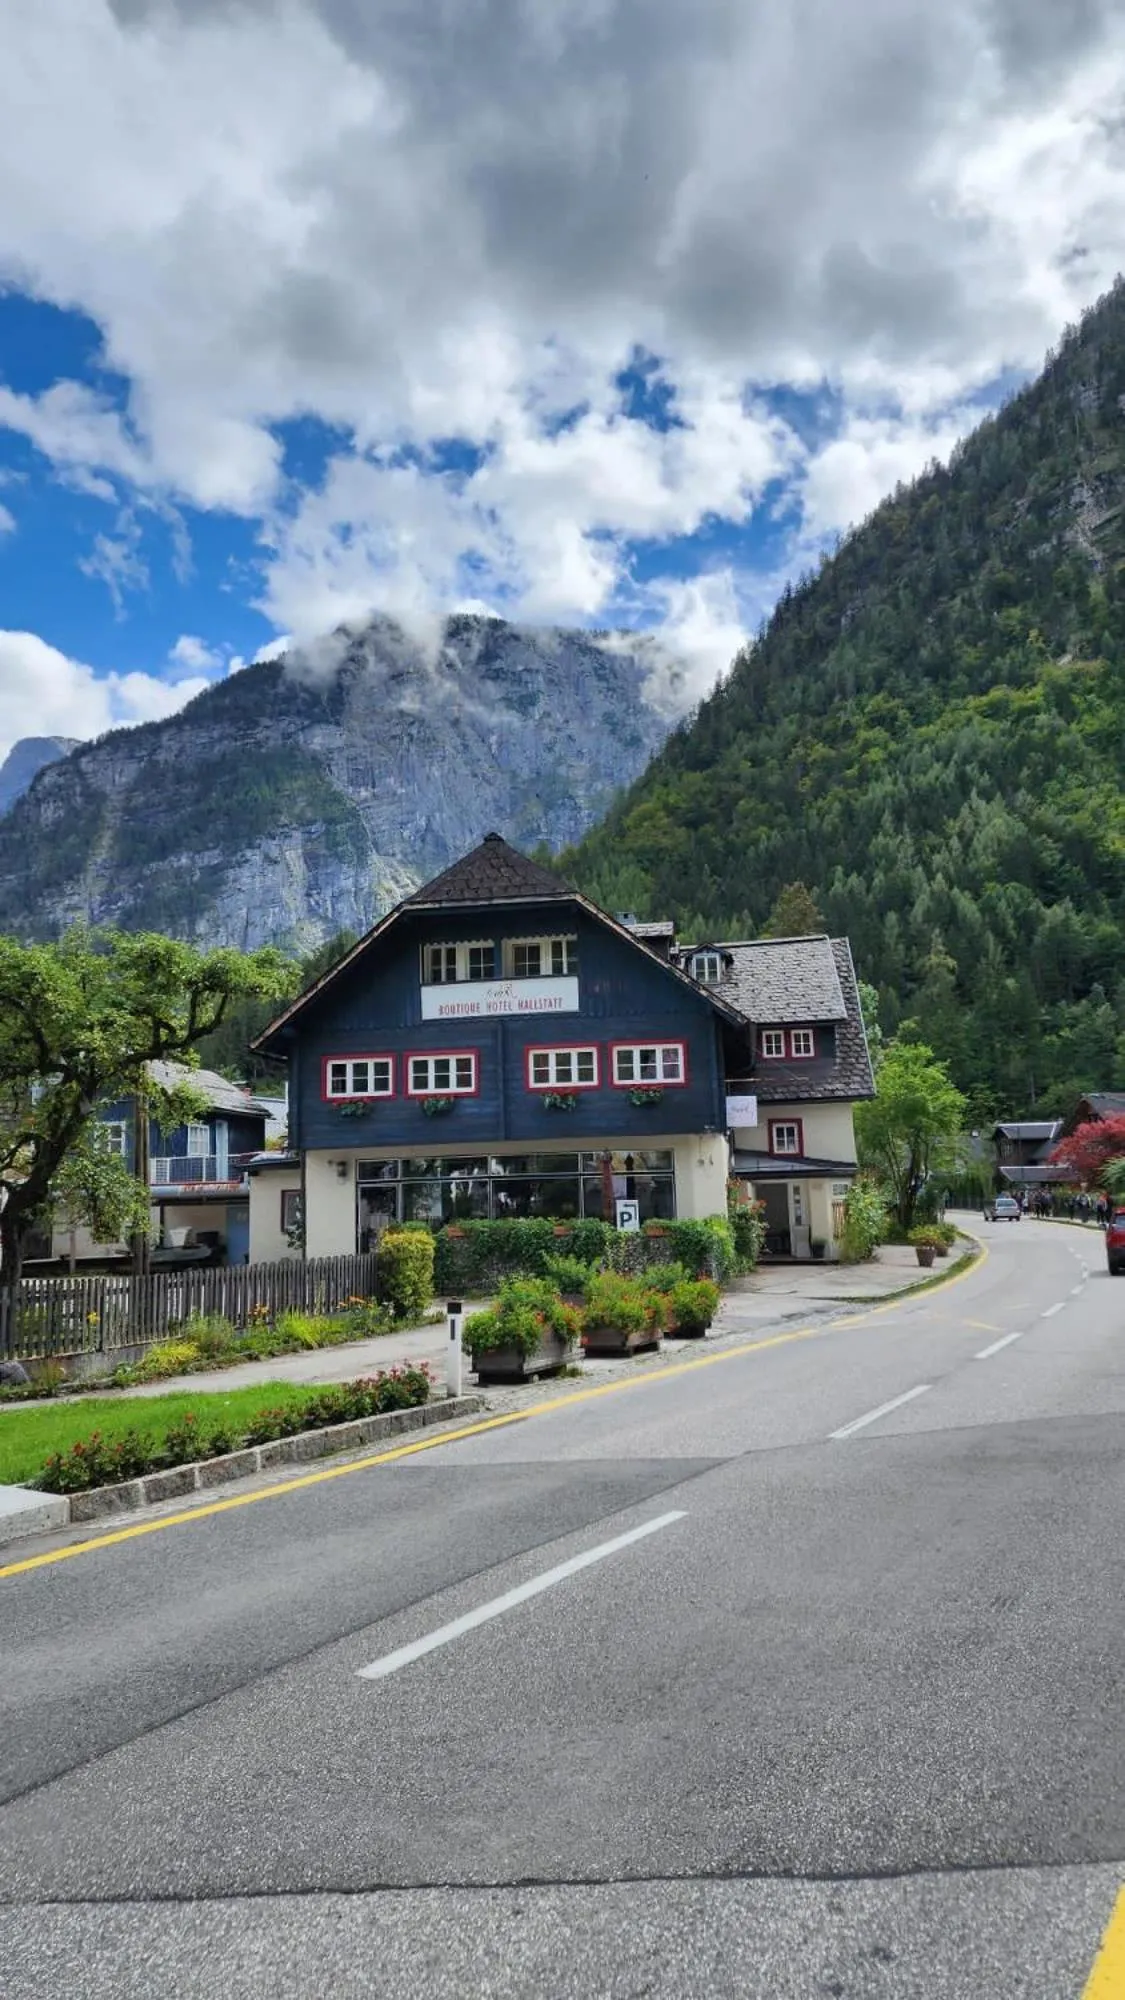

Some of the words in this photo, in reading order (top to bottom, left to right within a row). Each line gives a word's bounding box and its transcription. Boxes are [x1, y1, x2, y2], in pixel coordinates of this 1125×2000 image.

[438, 1002, 480, 1016] BOUTIQUE
[486, 1000, 512, 1013] HOTEL
[518, 997, 563, 1011] HALLSTATT
[620, 1211, 633, 1227] P
